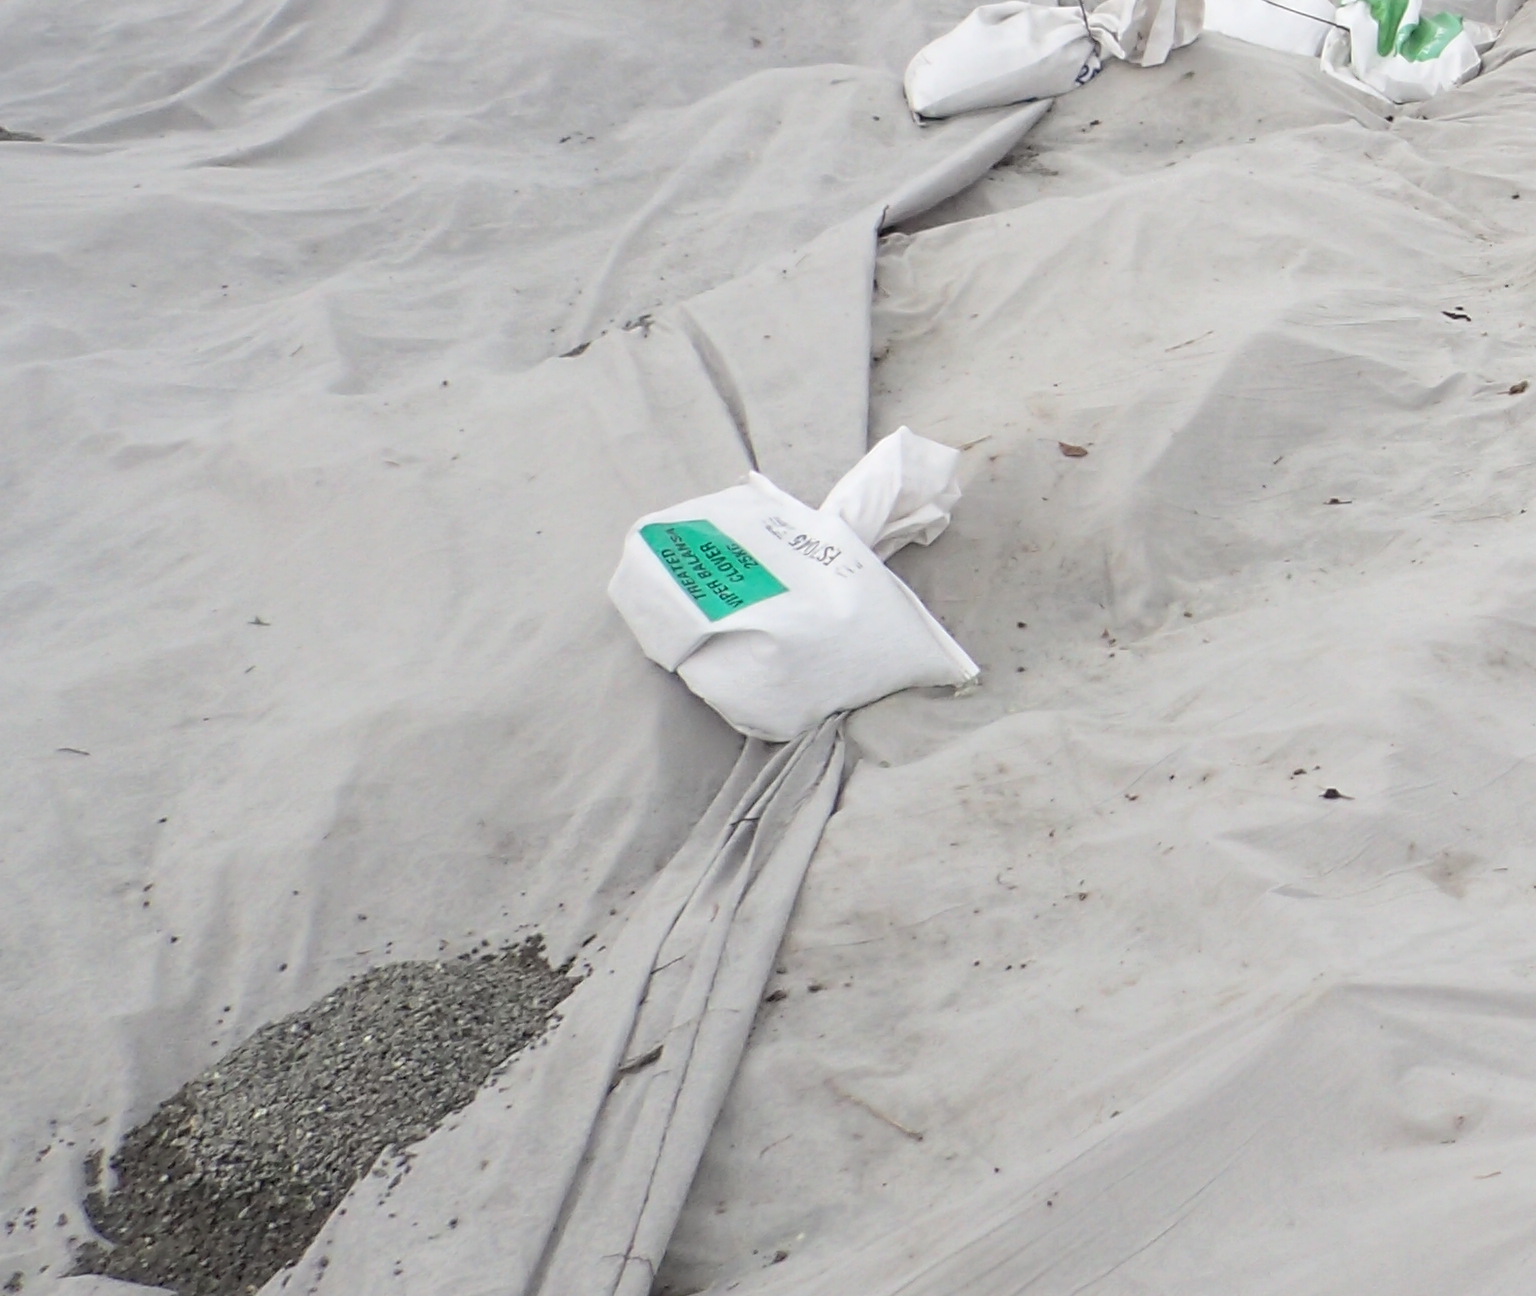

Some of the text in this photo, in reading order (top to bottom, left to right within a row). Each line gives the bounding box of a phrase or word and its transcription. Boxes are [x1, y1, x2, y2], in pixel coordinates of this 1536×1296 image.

[661, 549, 706, 600] TREATED
[666, 528, 744, 608] VIPER BALANSA
[700, 542, 744, 583] CLOVER
